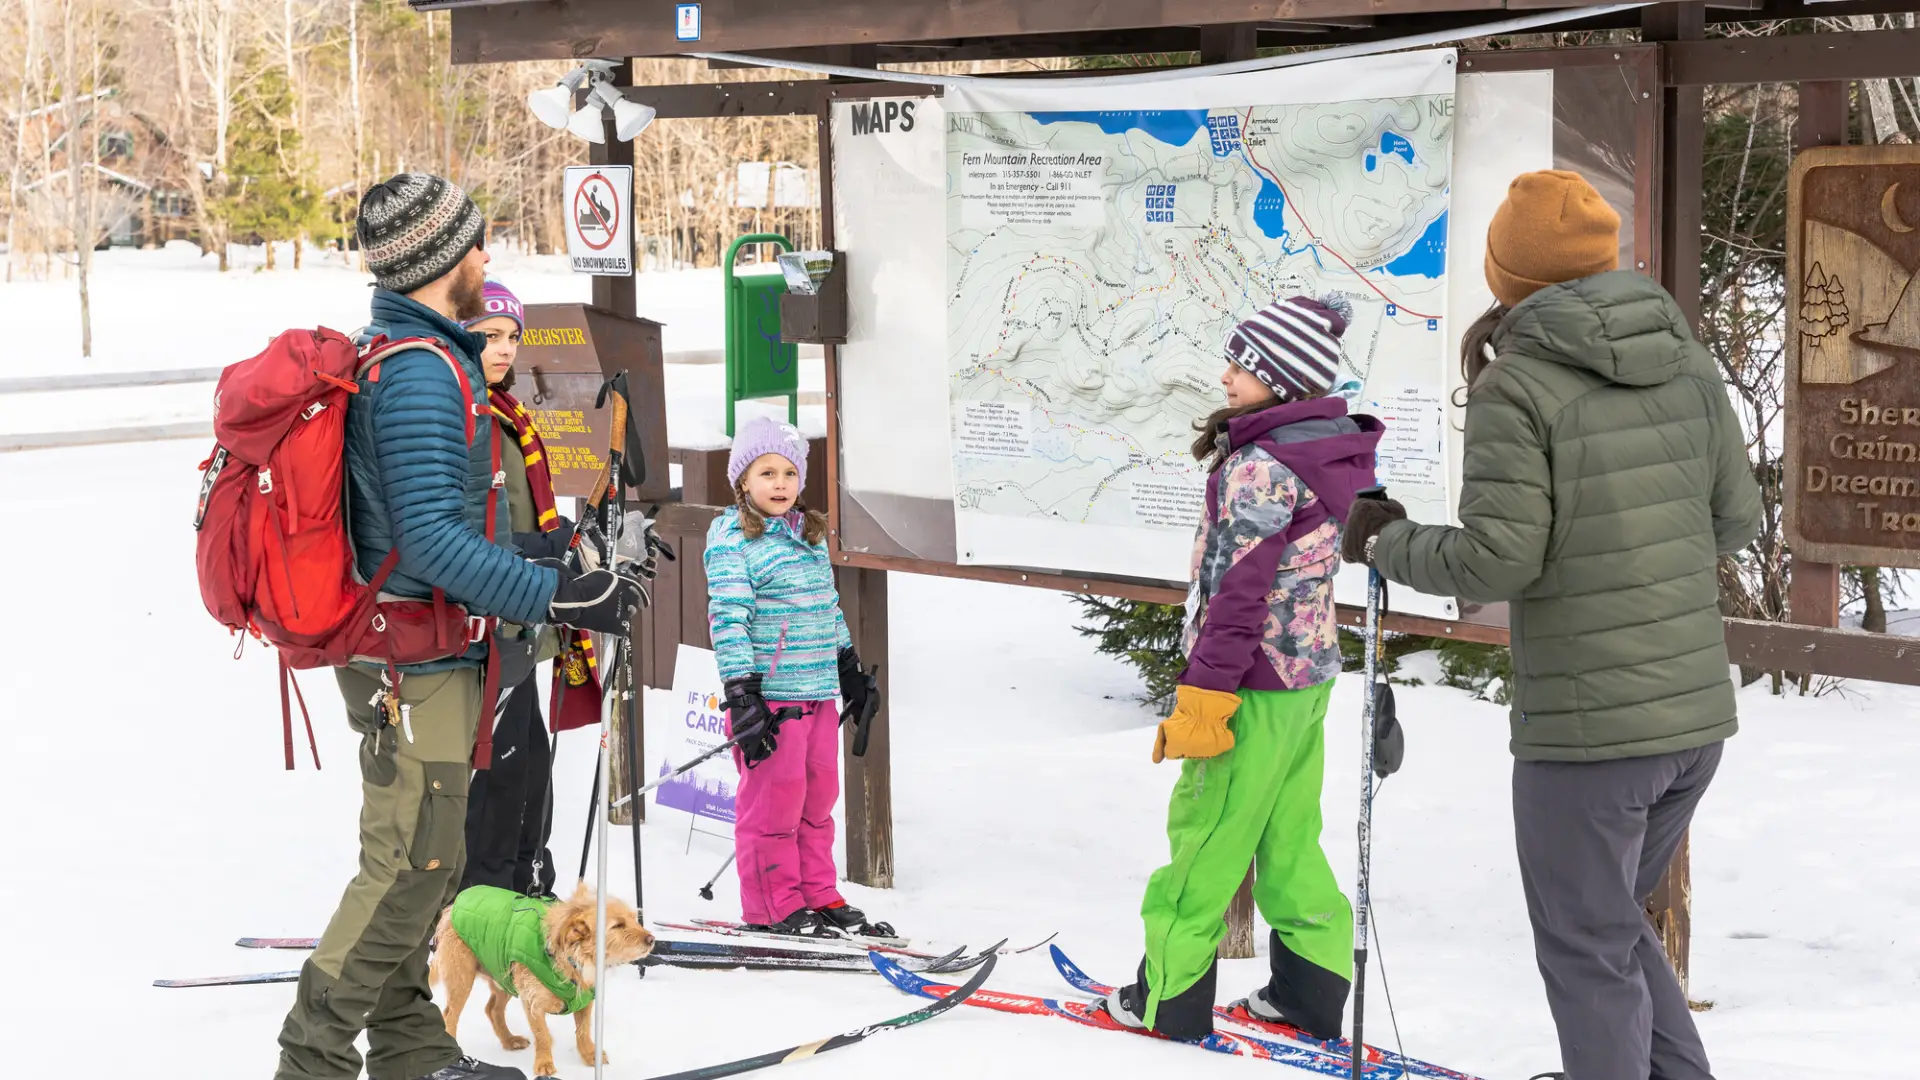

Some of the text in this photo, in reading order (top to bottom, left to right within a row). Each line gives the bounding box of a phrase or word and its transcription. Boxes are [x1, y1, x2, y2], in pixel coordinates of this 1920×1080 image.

[851, 101, 915, 136] MAPS
[951, 117, 974, 132] NW
[1248, 138, 1266, 146] Inlet
[963, 153, 1102, 166] Fern Mountain Recreation Area
[1002, 170, 1041, 179] 315-357-5501
[1006, 182, 1039, 193] Emergency
[1046, 182, 1059, 191] Call
[1060, 182, 1072, 191] 911
[573, 256, 627, 270] NO SNOWMOBILES
[485, 299, 521, 316] ON
[523, 327, 587, 346] REGISTER
[1224, 331, 1296, 404] L.Bea
[573, 410, 585, 419] THE
[552, 425, 586, 433] MAINTENANCE
[1829, 432, 1920, 463] Grim
[589, 462, 606, 470] LOCAT
[959, 494, 982, 508] SW
[687, 690, 699, 705] IF
[685, 709, 726, 735] CARR
